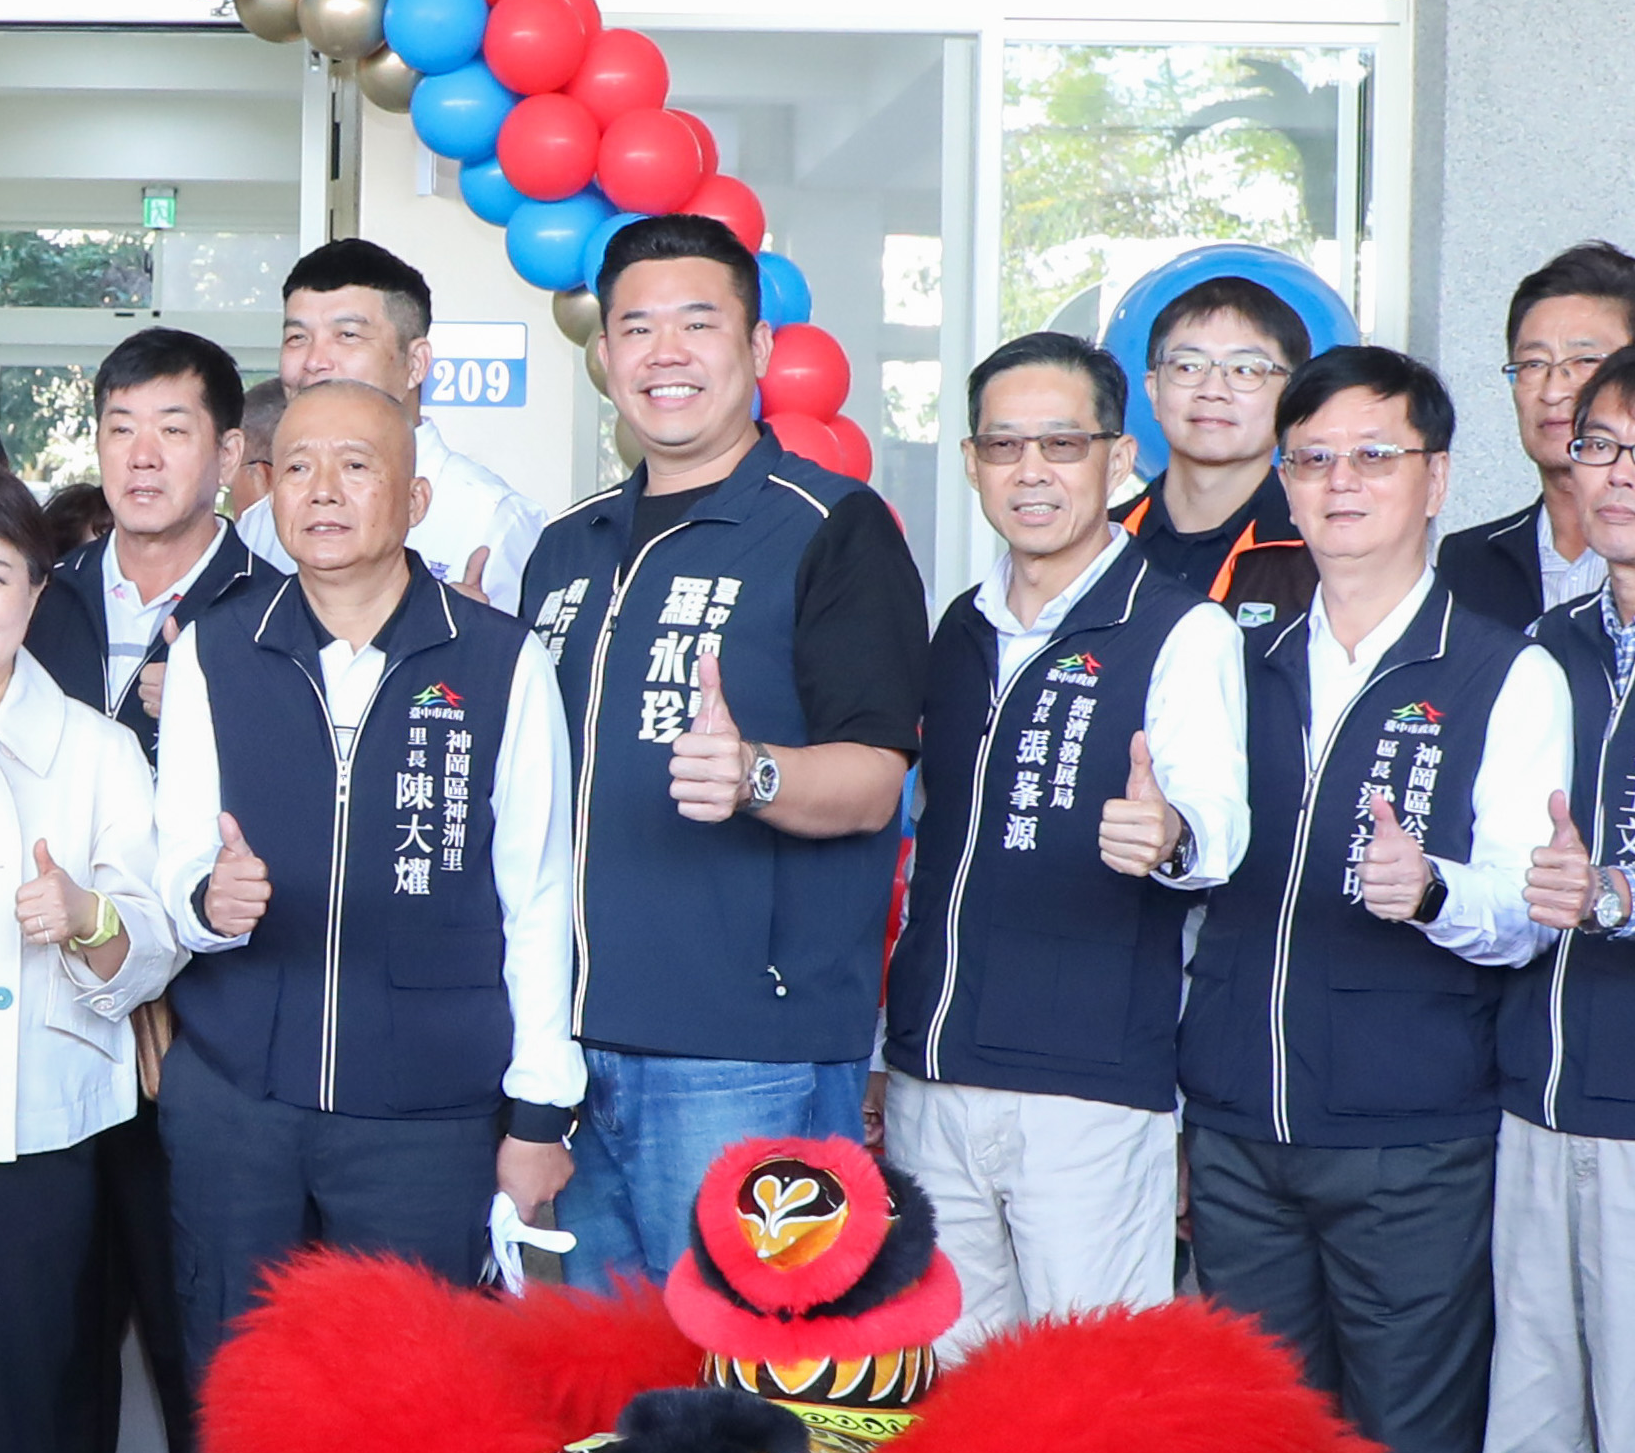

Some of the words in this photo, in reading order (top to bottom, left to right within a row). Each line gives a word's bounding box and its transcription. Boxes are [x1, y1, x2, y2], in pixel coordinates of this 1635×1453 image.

[431, 359, 510, 403] 209
[408, 706, 465, 722] 臺中市政府
[638, 575, 714, 744] 羅永珍
[440, 729, 473, 872] 神岡區神洲里
[1048, 694, 1098, 810] 經濟發展局
[1400, 741, 1444, 851] 神岡區公
